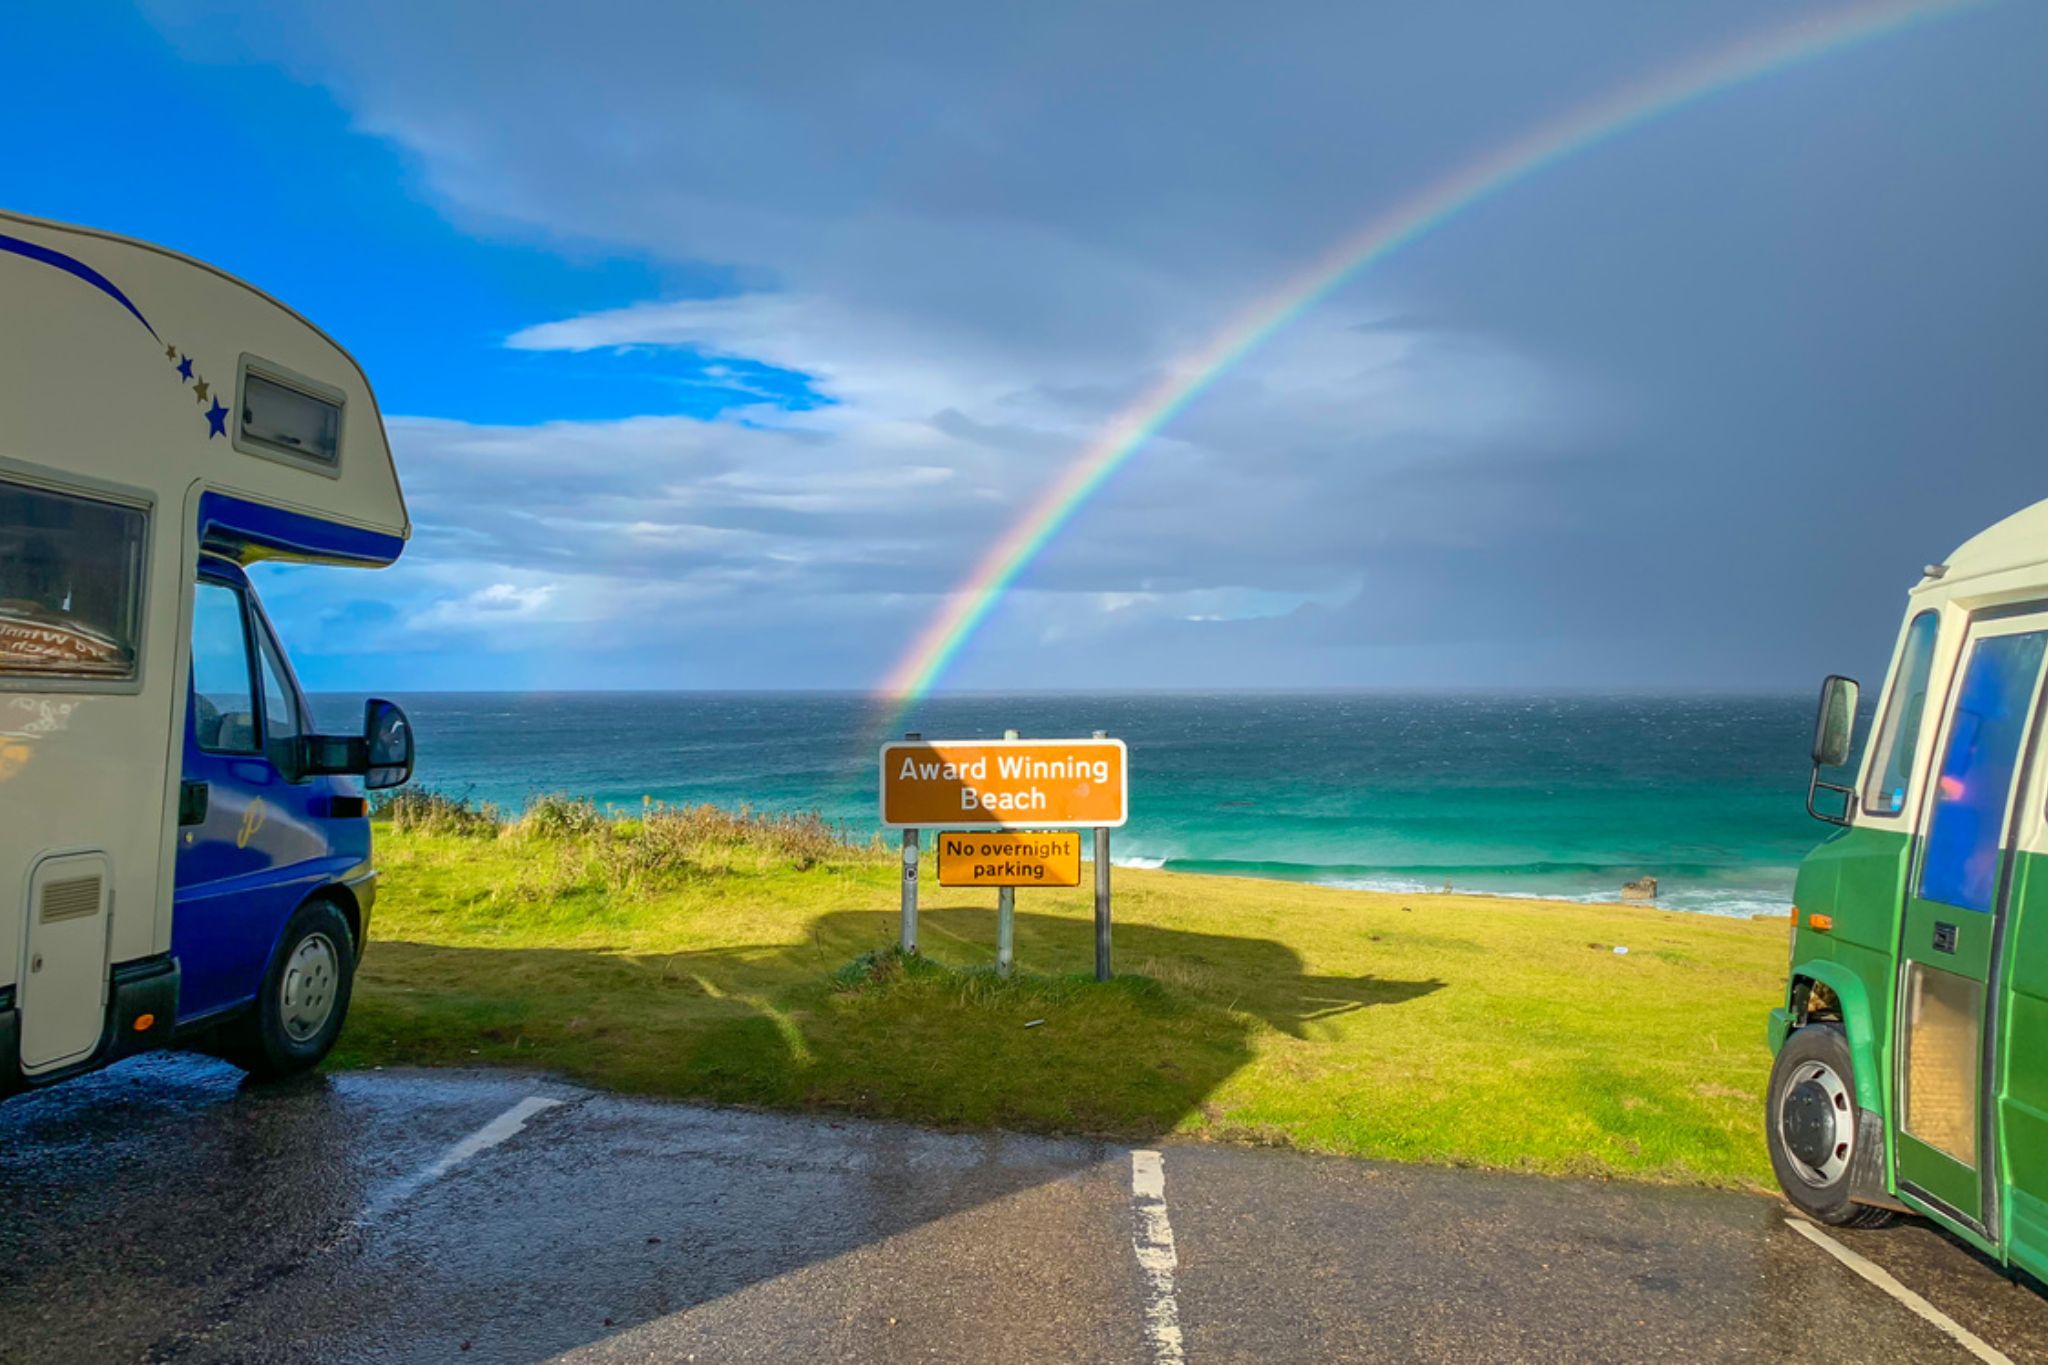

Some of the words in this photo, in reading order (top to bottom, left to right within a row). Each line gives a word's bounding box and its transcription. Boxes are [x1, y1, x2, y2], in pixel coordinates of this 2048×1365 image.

[900, 757, 986, 780] Award
[998, 756, 1109, 783] Winning
[961, 787, 1046, 811] Beach
[946, 841, 974, 857] No
[981, 841, 1071, 859] overnight
[974, 862, 1045, 879] parking
